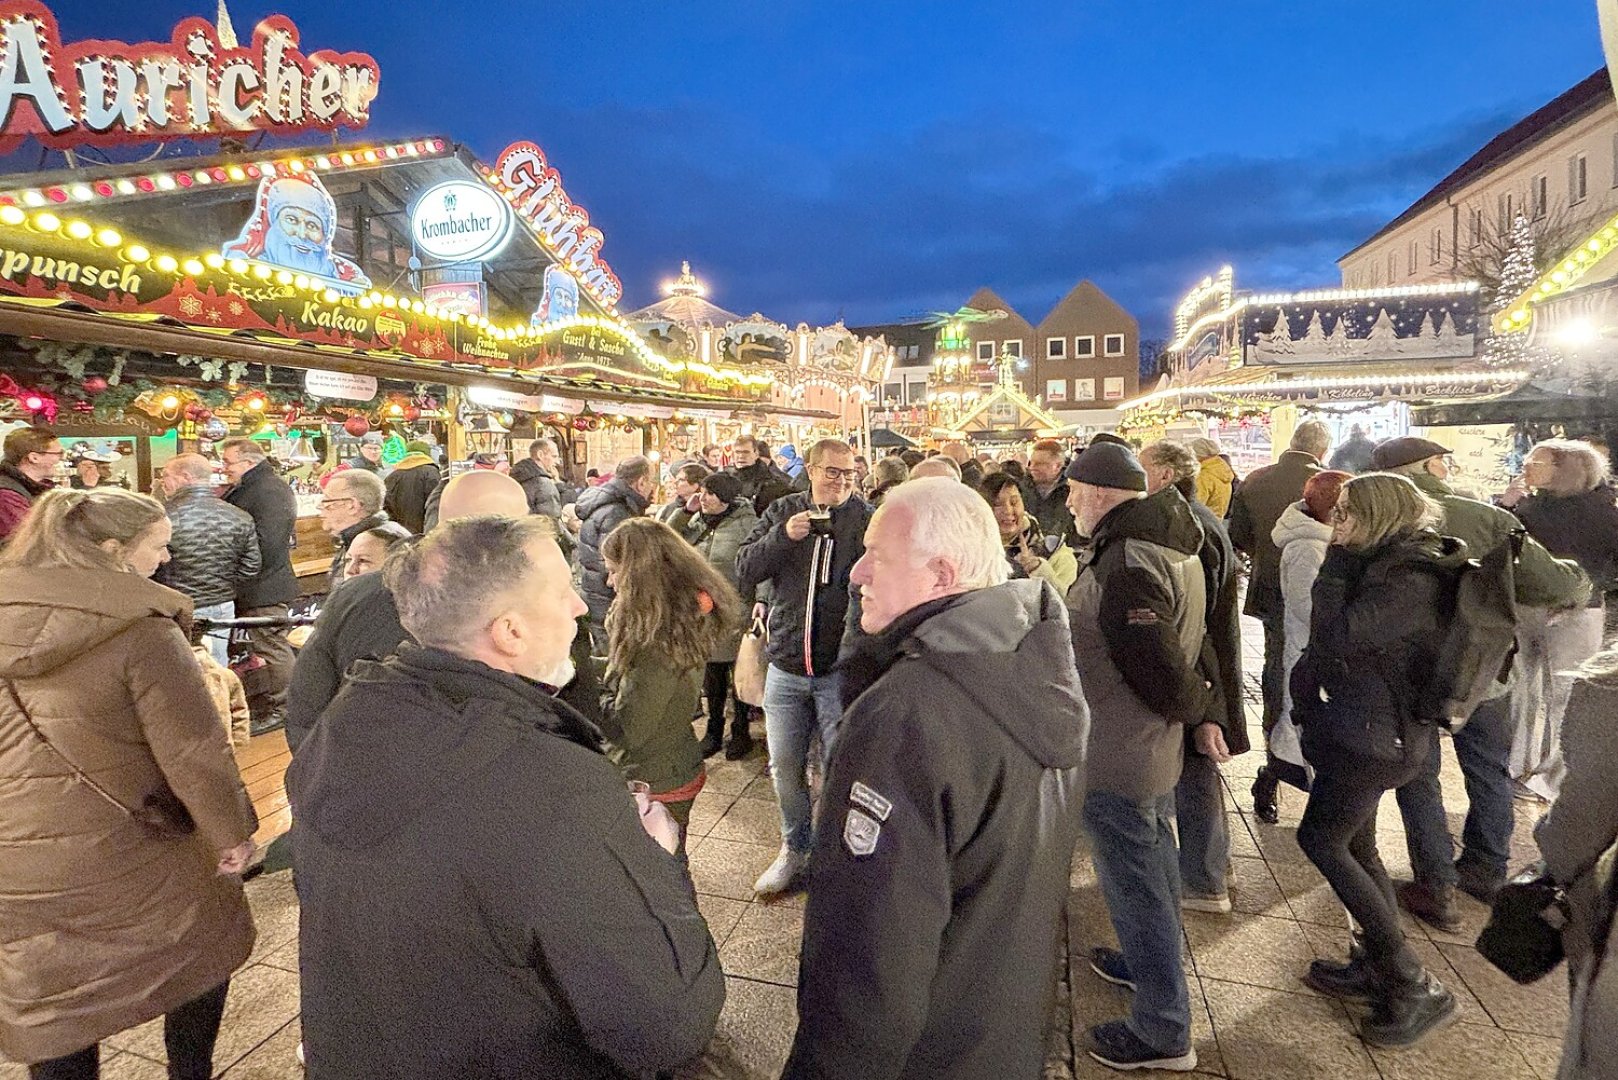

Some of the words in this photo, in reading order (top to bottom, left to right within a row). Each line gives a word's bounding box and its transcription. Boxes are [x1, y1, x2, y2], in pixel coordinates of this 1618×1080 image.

[0, 20, 371, 132] Auricher
[421, 212, 492, 239] Krombacher
[0, 248, 141, 294] punsch
[301, 301, 368, 333] Kakao
[563, 331, 586, 348] Gustl
[588, 336, 596, 351] &
[599, 338, 625, 356] Sascha
[1328, 388, 1375, 400] Kibbeling
[1425, 384, 1477, 396] Backfisch
